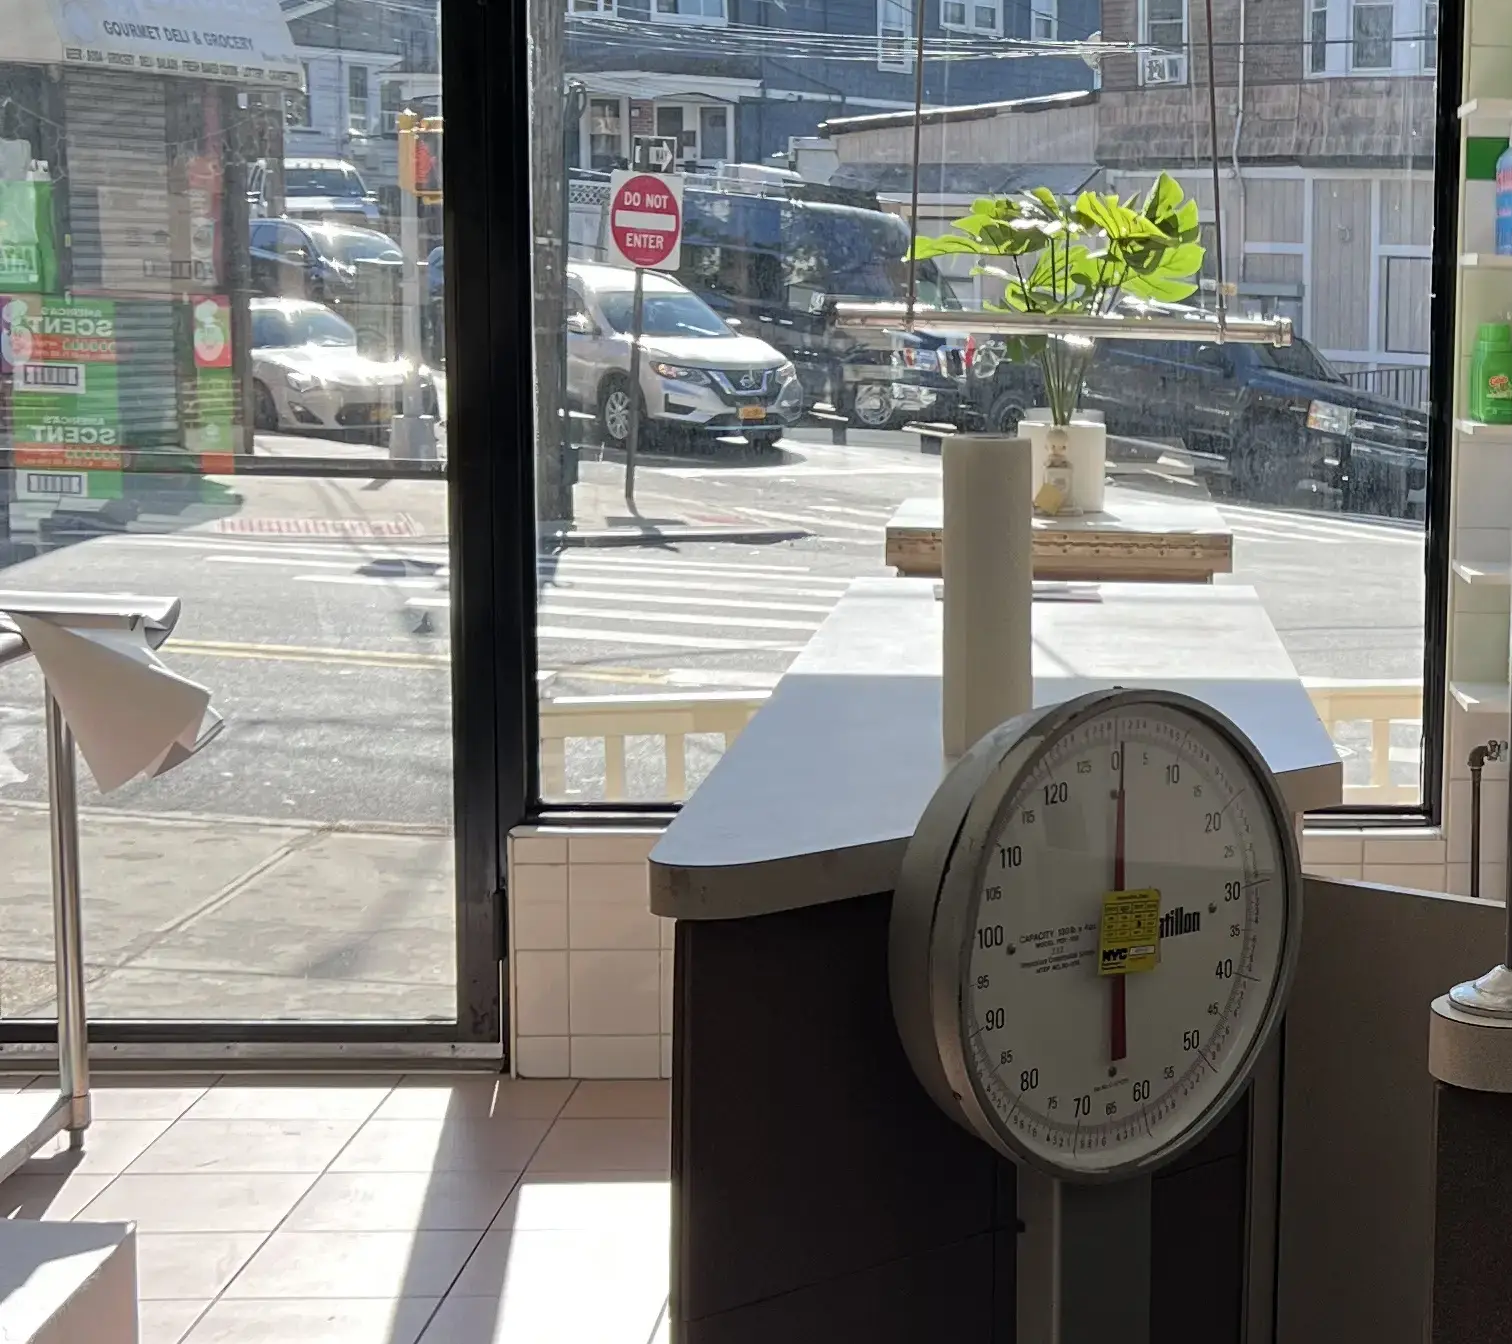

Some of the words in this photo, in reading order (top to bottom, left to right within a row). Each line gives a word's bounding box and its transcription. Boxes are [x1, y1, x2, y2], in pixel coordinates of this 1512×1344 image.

[103, 20, 161, 41] GOURMET
[163, 27, 190, 44] DELI
[193, 32, 202, 46] &
[203, 32, 254, 51] GROCERY
[623, 191, 641, 206] DO
[645, 194, 669, 209] NOT
[625, 233, 664, 249] ENTER
[1076, 760, 1092, 773] 125
[1110, 750, 1120, 771] 0
[1142, 752, 1149, 766] 5
[1166, 763, 1180, 784] 10
[1043, 782, 1068, 805] 120
[1193, 785, 1202, 797] 15
[1205, 812, 1222, 833] 20
[1000, 845, 1022, 869] 110
[1224, 845, 1235, 858] 25
[985, 886, 1002, 902] 105
[1224, 881, 1241, 902] 30
[1159, 907, 1201, 939] atillon
[1230, 924, 1241, 938] 35
[977, 925, 1004, 949] 100
[1019, 928, 1054, 944] CAPACITY
[1102, 948, 1128, 962] NYC
[1215, 958, 1233, 979] 40
[976, 975, 990, 990] 95
[1206, 1002, 1218, 1016] 45
[985, 1007, 1005, 1032] 90
[1183, 1029, 1200, 1051] 50
[1000, 1051, 1013, 1065] 85
[1020, 1067, 1039, 1092] 80
[1163, 1065, 1175, 1080] 55
[1133, 1079, 1150, 1102] 60
[1047, 1096, 1058, 1110] 75
[1073, 1094, 1091, 1118] 70
[1105, 1100, 1117, 1116] 65
